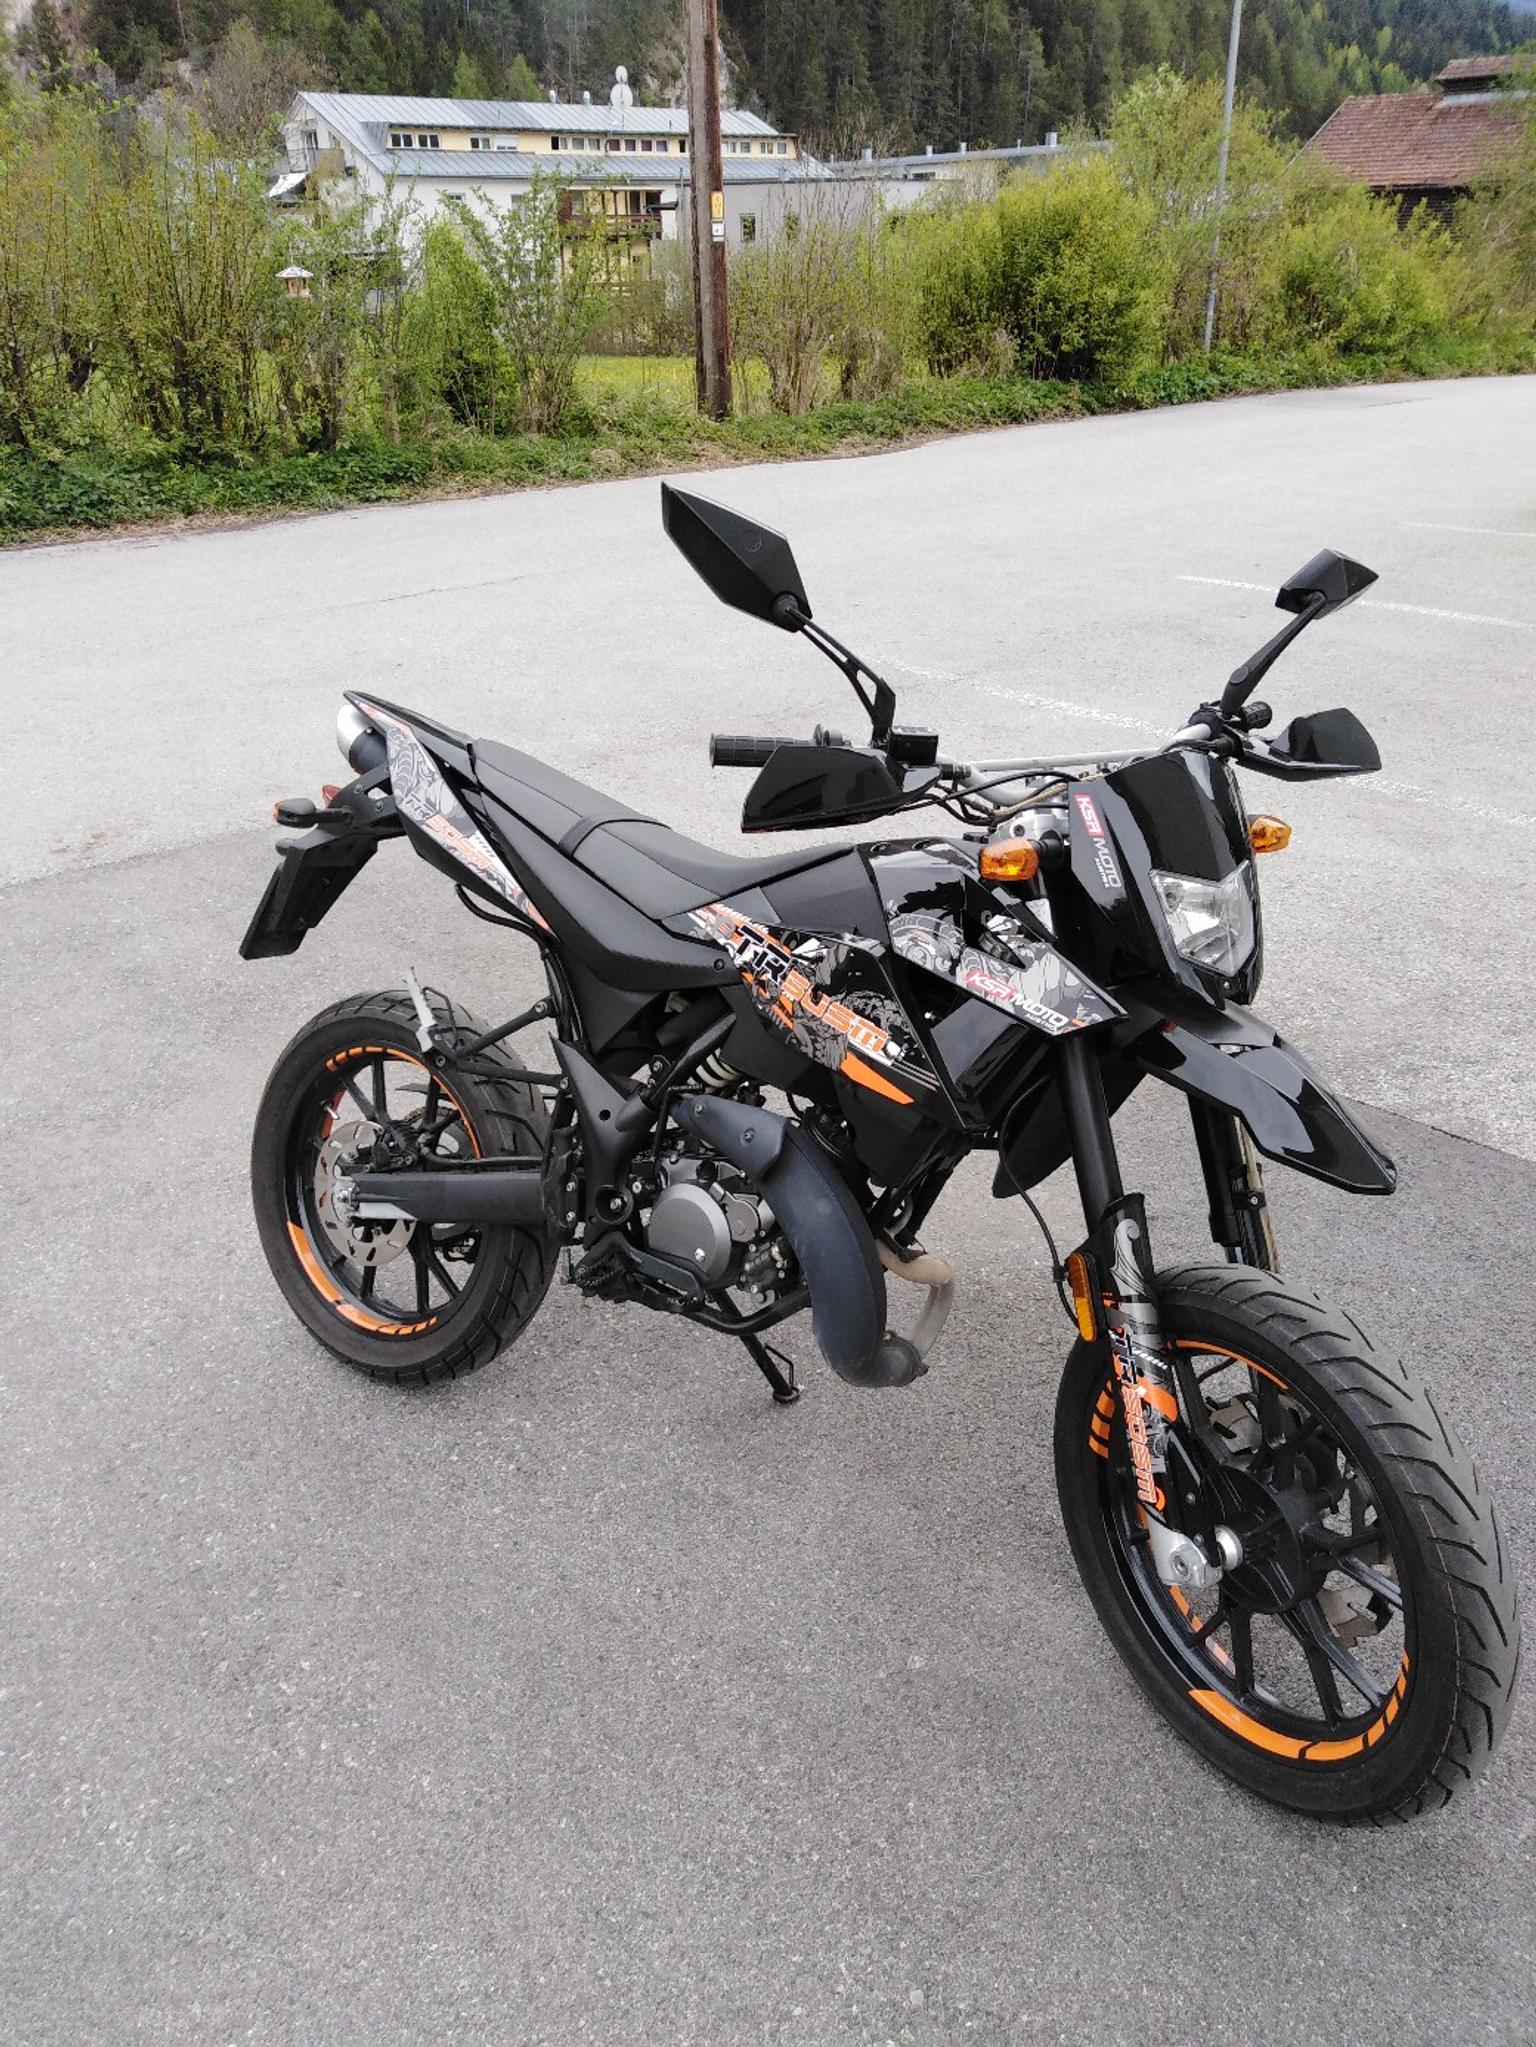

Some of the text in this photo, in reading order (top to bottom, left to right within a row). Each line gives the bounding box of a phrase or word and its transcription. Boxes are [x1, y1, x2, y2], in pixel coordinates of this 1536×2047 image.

[1074, 794, 1122, 888] KSR MOTO
[1009, 993, 1069, 1028] MOTO
